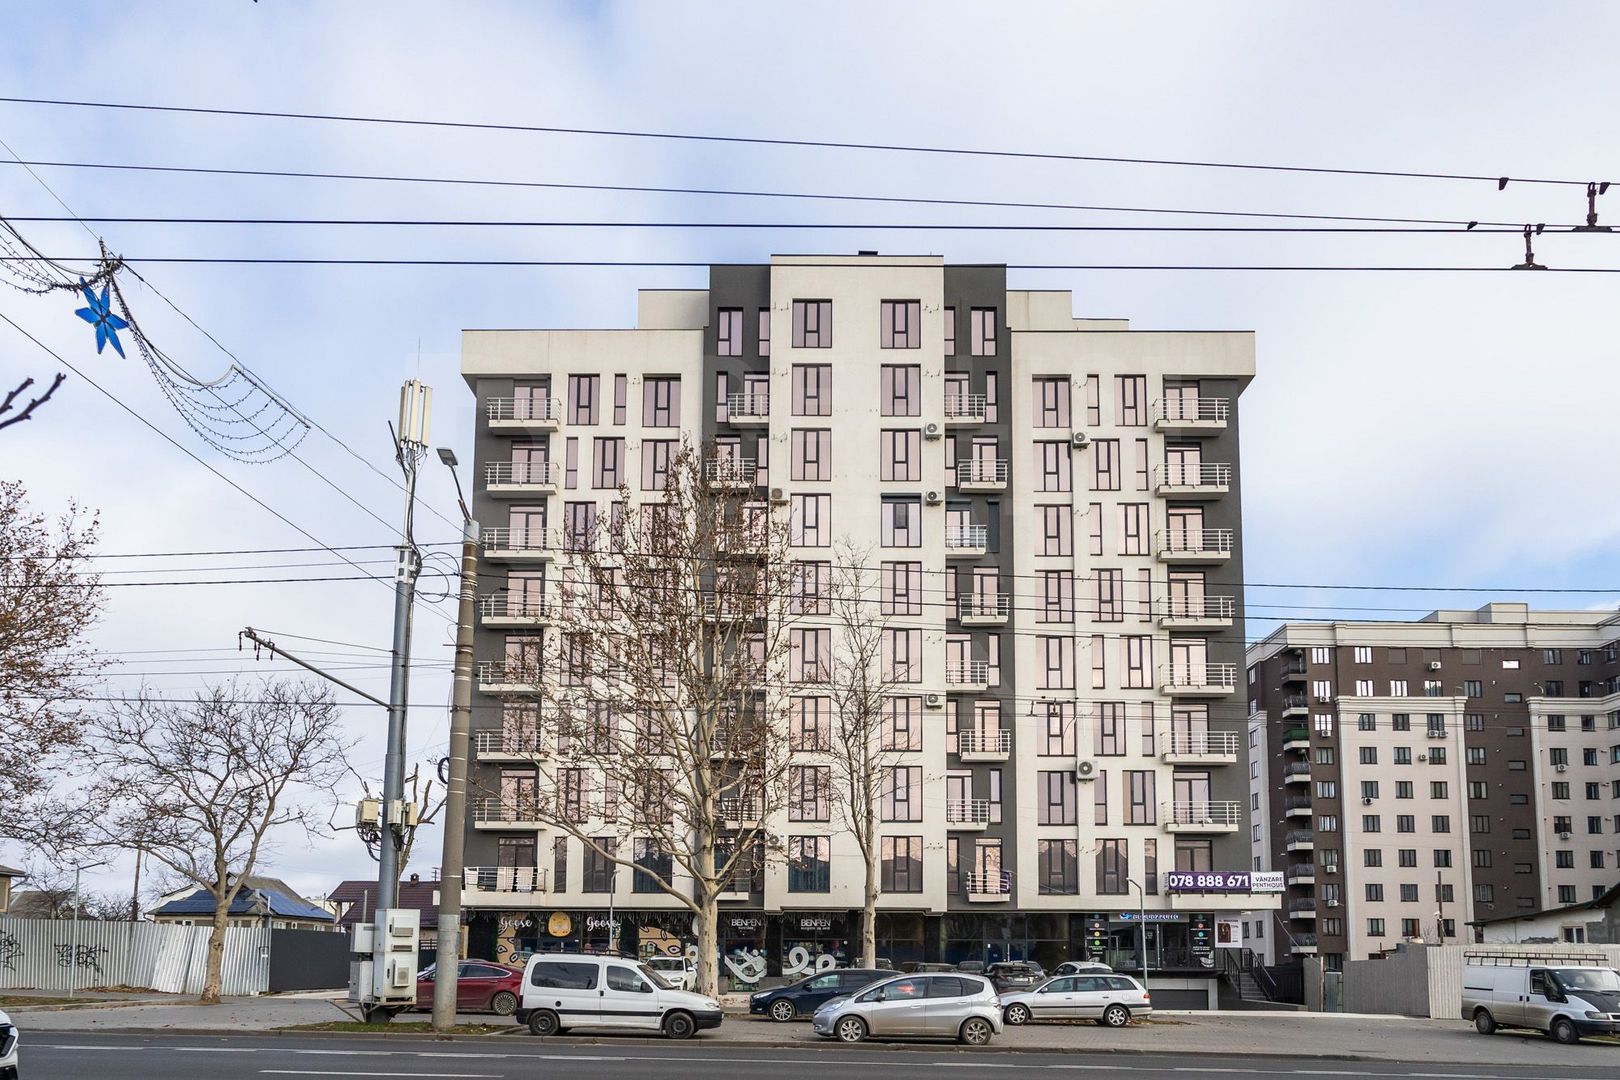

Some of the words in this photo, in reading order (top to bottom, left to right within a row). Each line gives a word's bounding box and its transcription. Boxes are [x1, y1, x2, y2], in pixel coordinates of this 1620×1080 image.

[1169, 875, 1194, 887] 078
[1197, 875, 1223, 887] 888
[1227, 875, 1249, 887] 671
[731, 918, 761, 927] BENPEN
[800, 918, 831, 927] BENPEN
